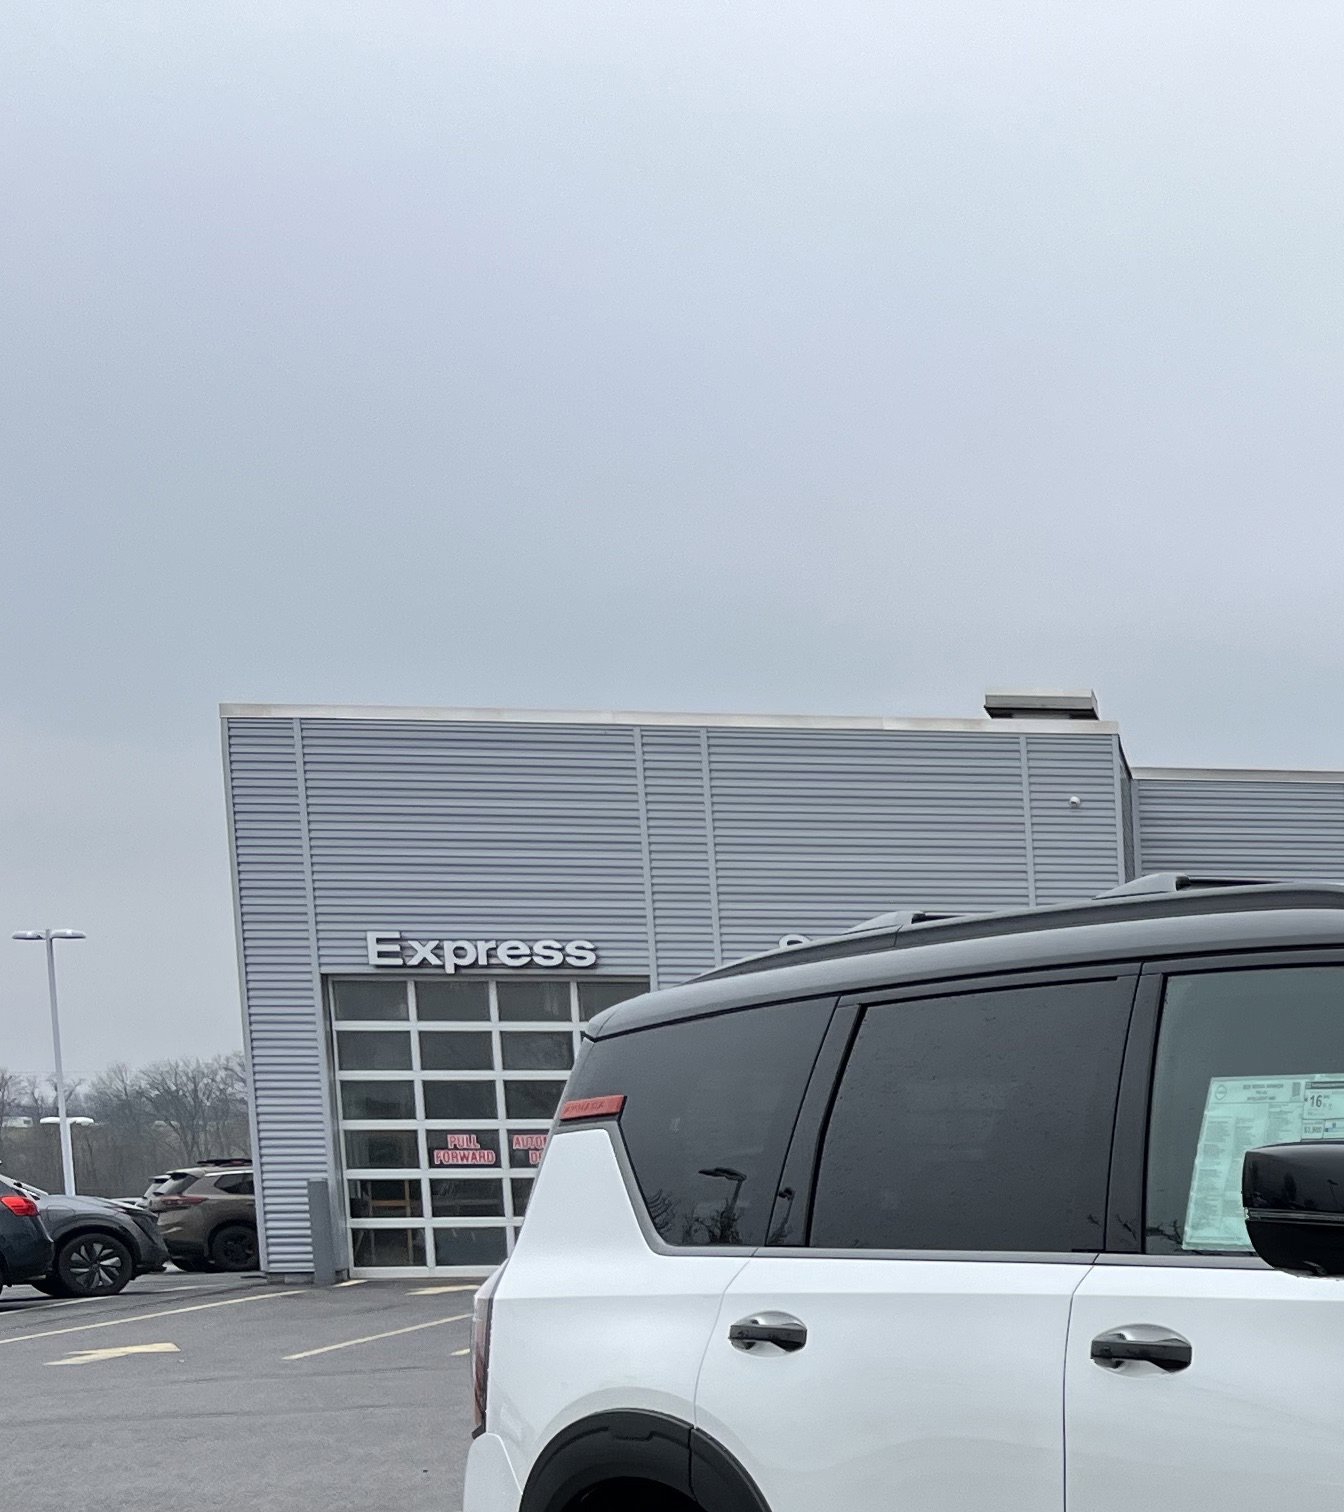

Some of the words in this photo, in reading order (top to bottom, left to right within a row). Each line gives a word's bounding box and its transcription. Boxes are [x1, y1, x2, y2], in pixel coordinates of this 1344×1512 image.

[366, 931, 597, 975] Express
[1310, 1094, 1323, 1108] 16
[447, 1134, 480, 1149] PULL
[434, 1150, 496, 1165] FORWARD
